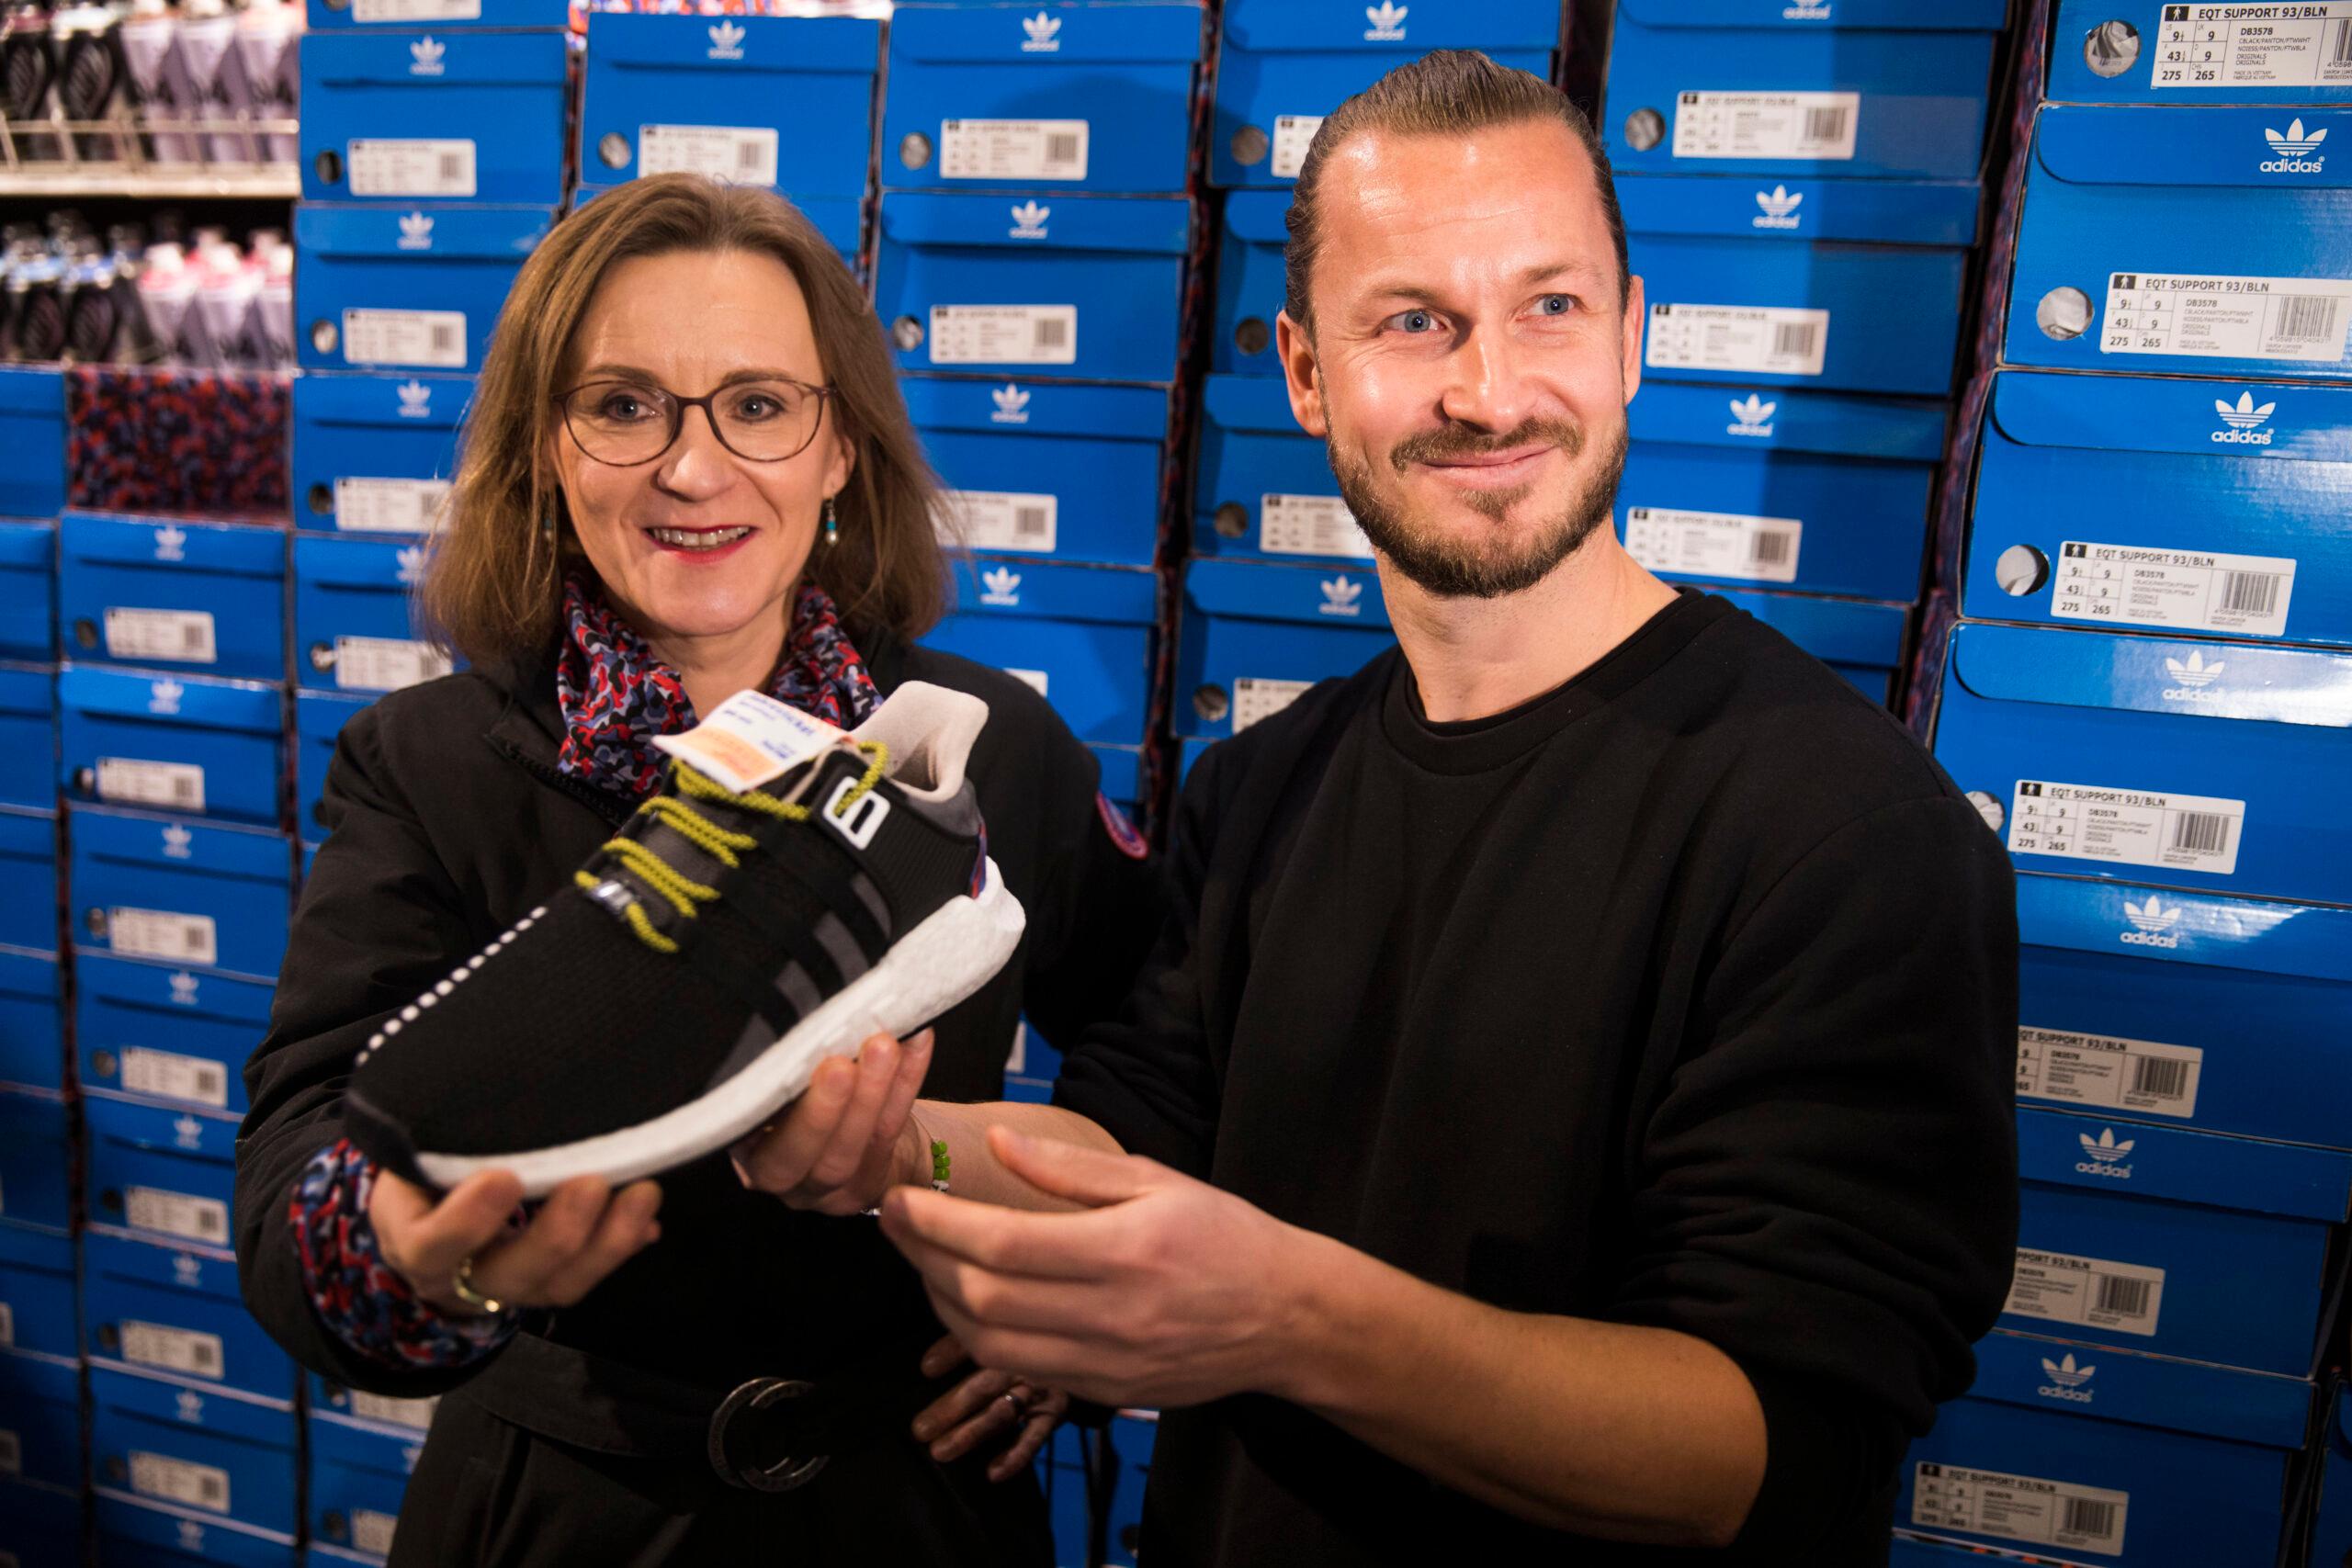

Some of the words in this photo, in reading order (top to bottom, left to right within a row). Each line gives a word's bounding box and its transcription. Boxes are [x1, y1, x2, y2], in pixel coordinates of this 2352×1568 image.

[2199, 8, 2222, 20] EQT
[2223, 7, 2279, 18] SUPPORT
[2282, 6, 2328, 19] 93/BLN
[2208, 30, 2215, 41] 9
[2241, 28, 2274, 36] DB3578
[2204, 51, 2212, 62] 9
[2162, 71, 2182, 81] 275
[2195, 70, 2215, 81] 265
[2260, 159, 2323, 174] adidas
[2145, 278, 2168, 291] EQT
[2170, 278, 2223, 291] SUPPORT
[2226, 281, 2269, 294] 93/BLN
[2154, 300, 2161, 310] 9
[2186, 299, 2218, 308] DB3578
[2152, 319, 2158, 330] 9
[2109, 336, 2129, 346] 275
[2142, 337, 2161, 348] 265
[2096, 548, 2117, 560] EQT
[2119, 550, 2170, 563] SUPPORT
[2173, 555, 2214, 568] 93/BLN
[2104, 570, 2111, 580] 9
[2101, 587, 2109, 598] 9
[2062, 602, 2080, 613] 275
[2092, 604, 2111, 615] 265
[2051, 787, 2072, 799] EQT
[2074, 790, 2123, 803] SUPPORT
[2126, 795, 2165, 807] 93/BLN
[2018, 838, 2036, 849] 275
[2018, 1030, 2035, 1042] QT
